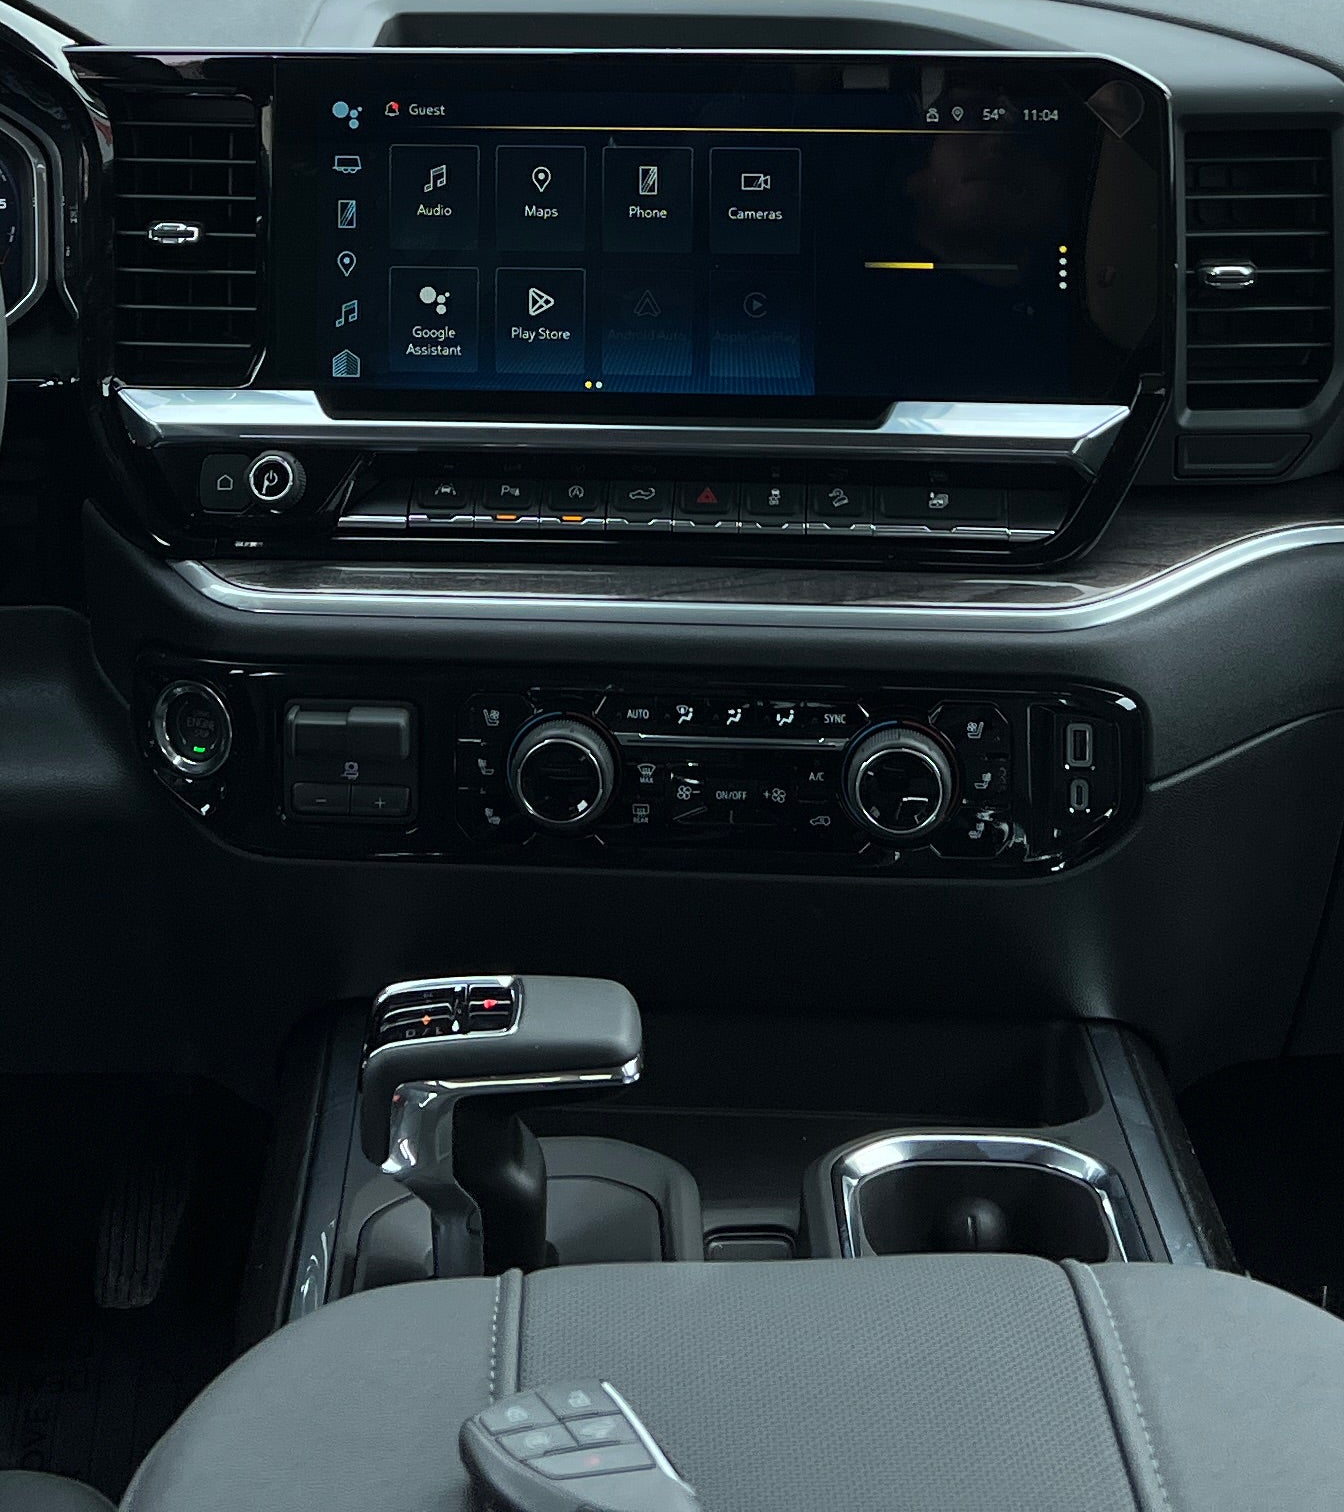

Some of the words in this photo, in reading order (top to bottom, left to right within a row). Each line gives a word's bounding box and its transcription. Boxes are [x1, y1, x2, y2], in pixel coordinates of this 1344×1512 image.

[408, 103, 446, 116] Guest
[982, 108, 1006, 121] 54°
[1023, 109, 1059, 121] 11:04
[417, 204, 452, 217] Audio
[524, 205, 559, 220] Maps
[628, 206, 668, 219] Phone
[728, 207, 783, 220] Cameras
[412, 325, 456, 342] Google
[511, 326, 536, 343] Play
[538, 327, 571, 340] Store
[406, 343, 462, 356] Assistant
[626, 708, 650, 720] AUTO
[823, 713, 847, 725] SYNC
[808, 771, 825, 782] A/C
[715, 790, 748, 801] ON/OFF
